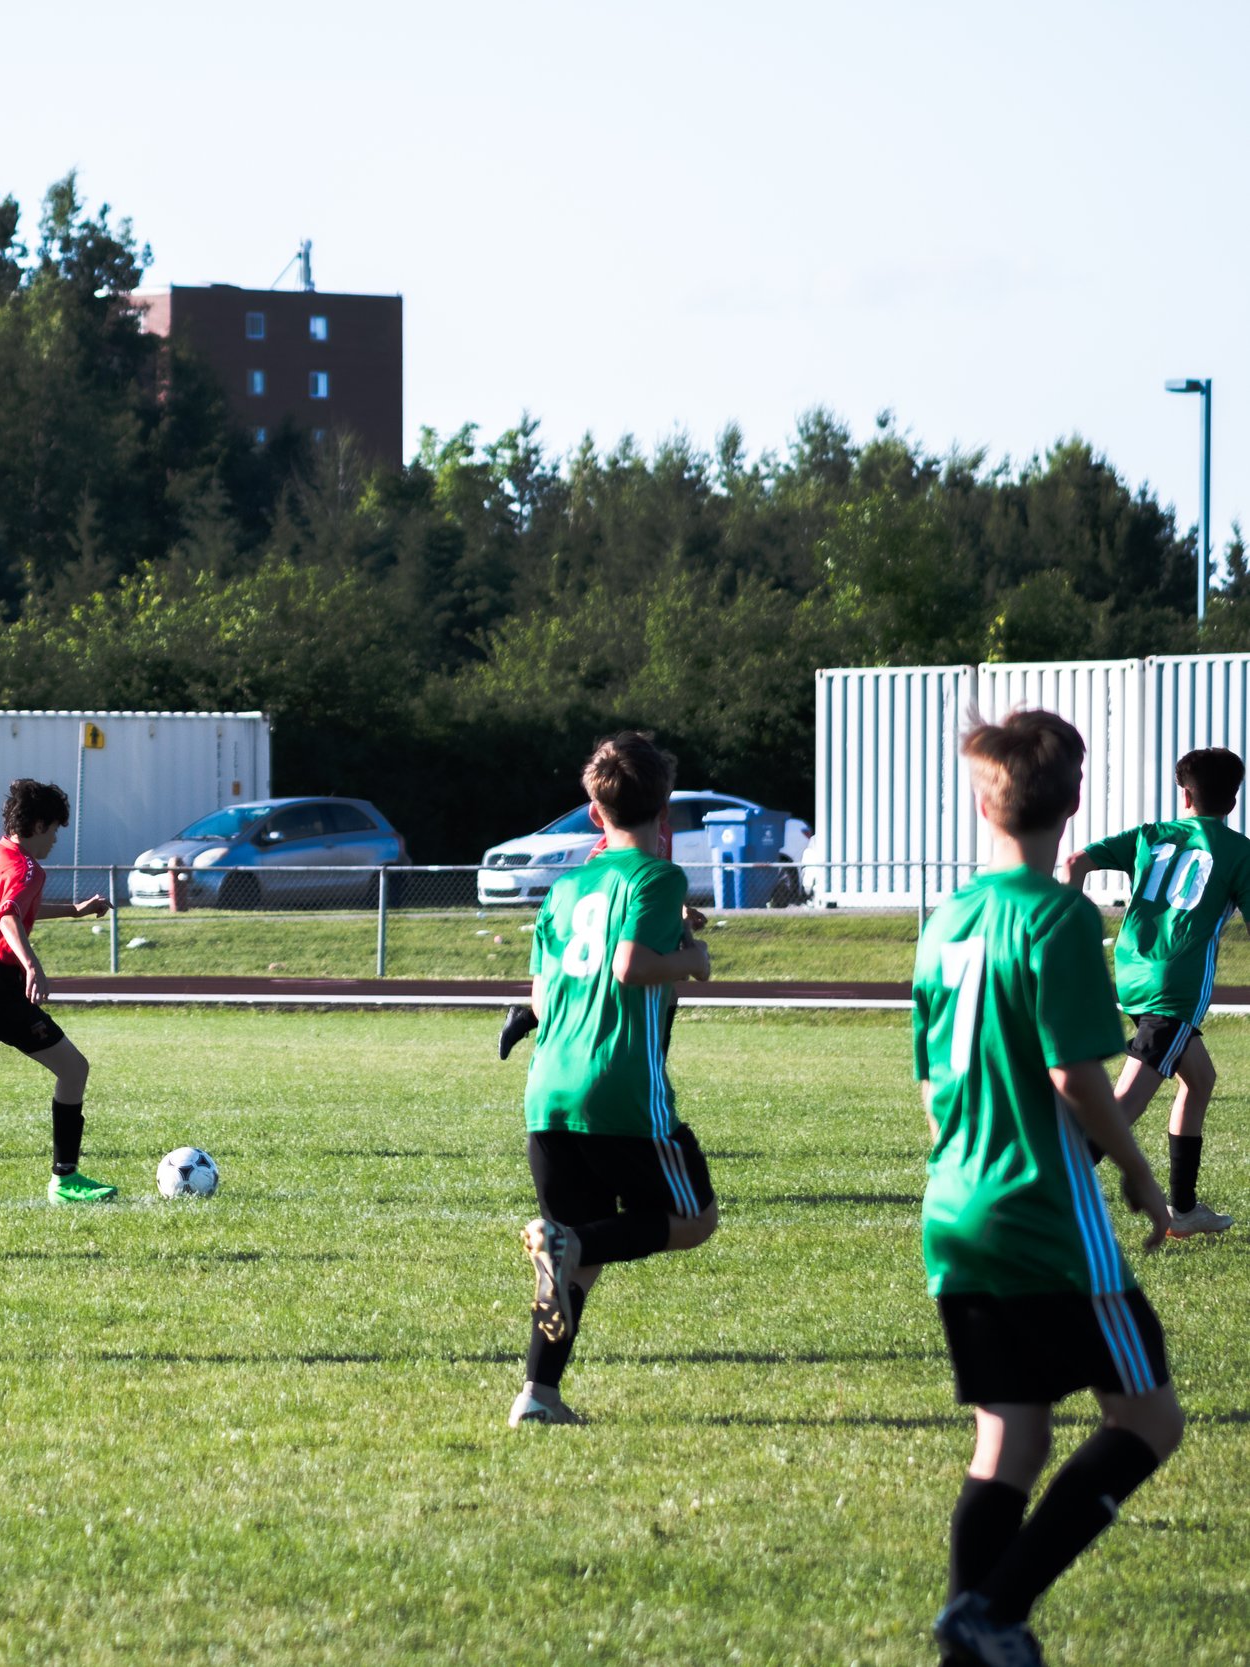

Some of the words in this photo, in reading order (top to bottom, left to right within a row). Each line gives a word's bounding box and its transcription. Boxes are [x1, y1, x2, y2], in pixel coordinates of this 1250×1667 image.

[1142, 842, 1214, 911] 10
[561, 891, 609, 977] 8
[940, 935, 986, 1074] 7
